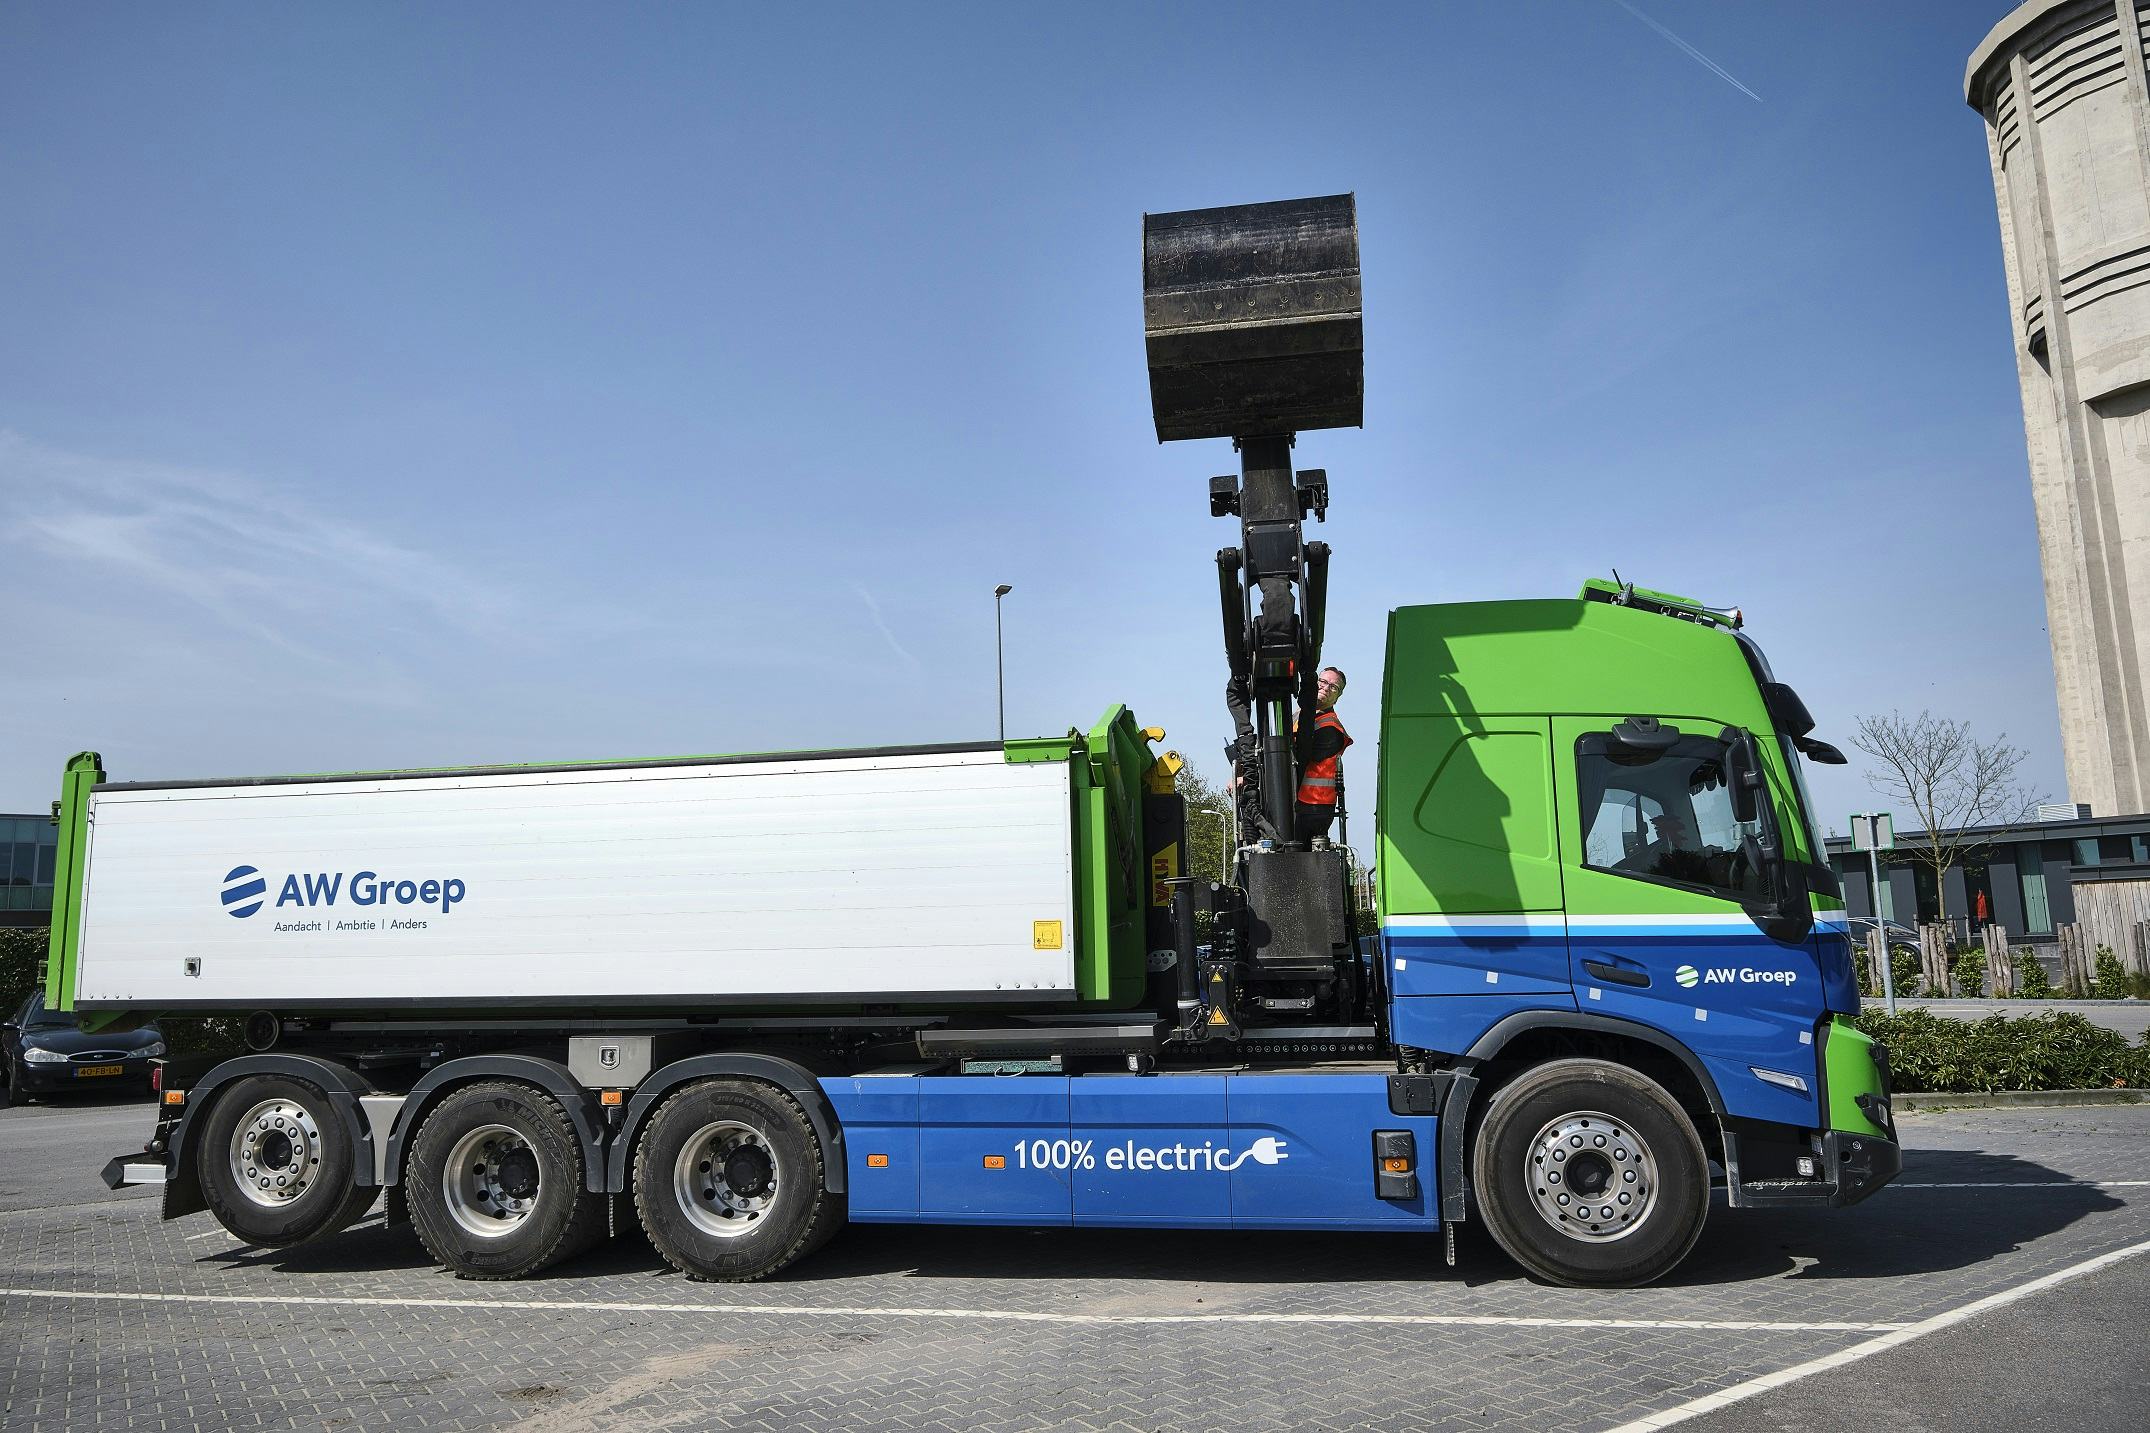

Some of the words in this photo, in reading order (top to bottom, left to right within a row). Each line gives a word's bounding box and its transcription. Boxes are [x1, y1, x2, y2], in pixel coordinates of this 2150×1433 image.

[275, 872, 343, 908] AW
[349, 871, 466, 914] Groep
[274, 920, 322, 932] Aandacht
[335, 919, 376, 931] Ambitie
[390, 918, 428, 930] Anders
[1703, 968, 1737, 984] AW
[1739, 967, 1797, 987] Groep
[1014, 1139, 1096, 1170] 100%
[1105, 1139, 1234, 1171] electric
